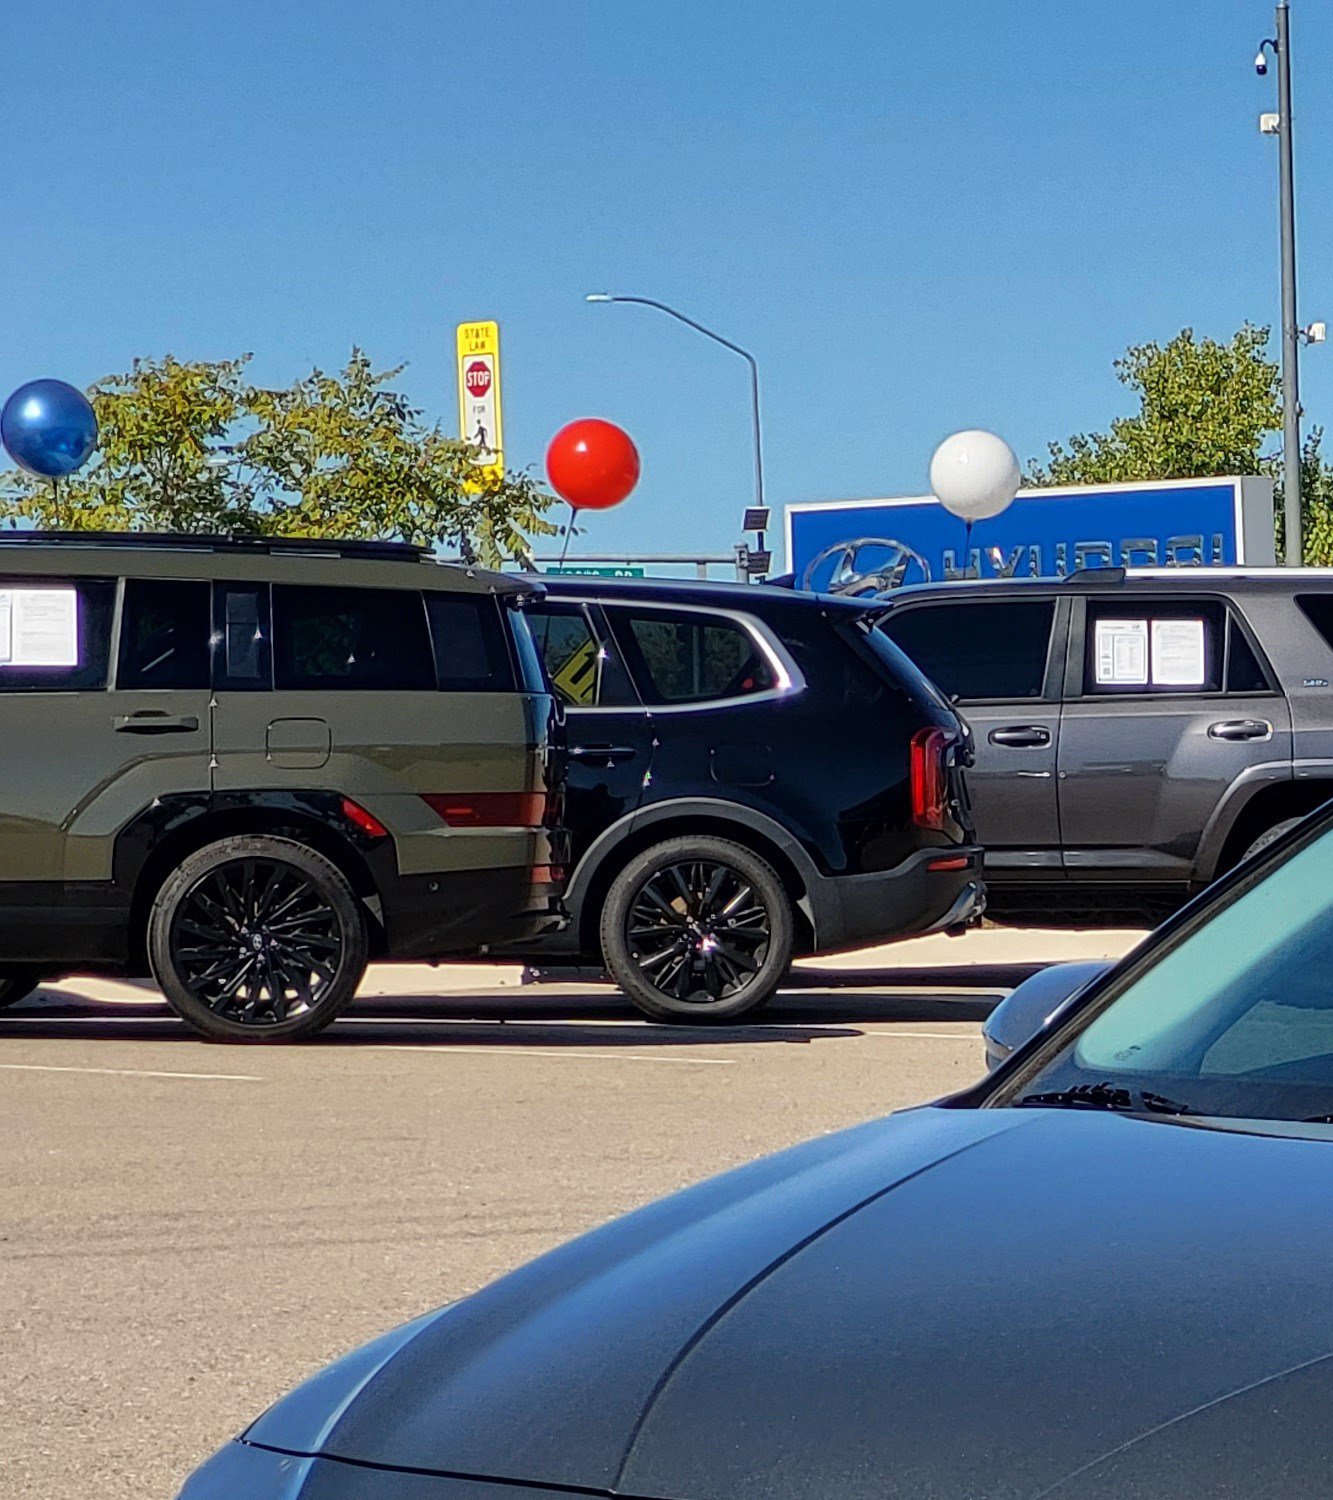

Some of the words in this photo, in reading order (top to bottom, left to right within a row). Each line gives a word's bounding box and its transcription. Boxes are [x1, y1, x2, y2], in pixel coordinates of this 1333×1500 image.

[464, 327, 490, 339] STATE
[469, 341, 486, 352] LAW
[467, 371, 491, 387] STOP
[472, 404, 487, 415] FOR
